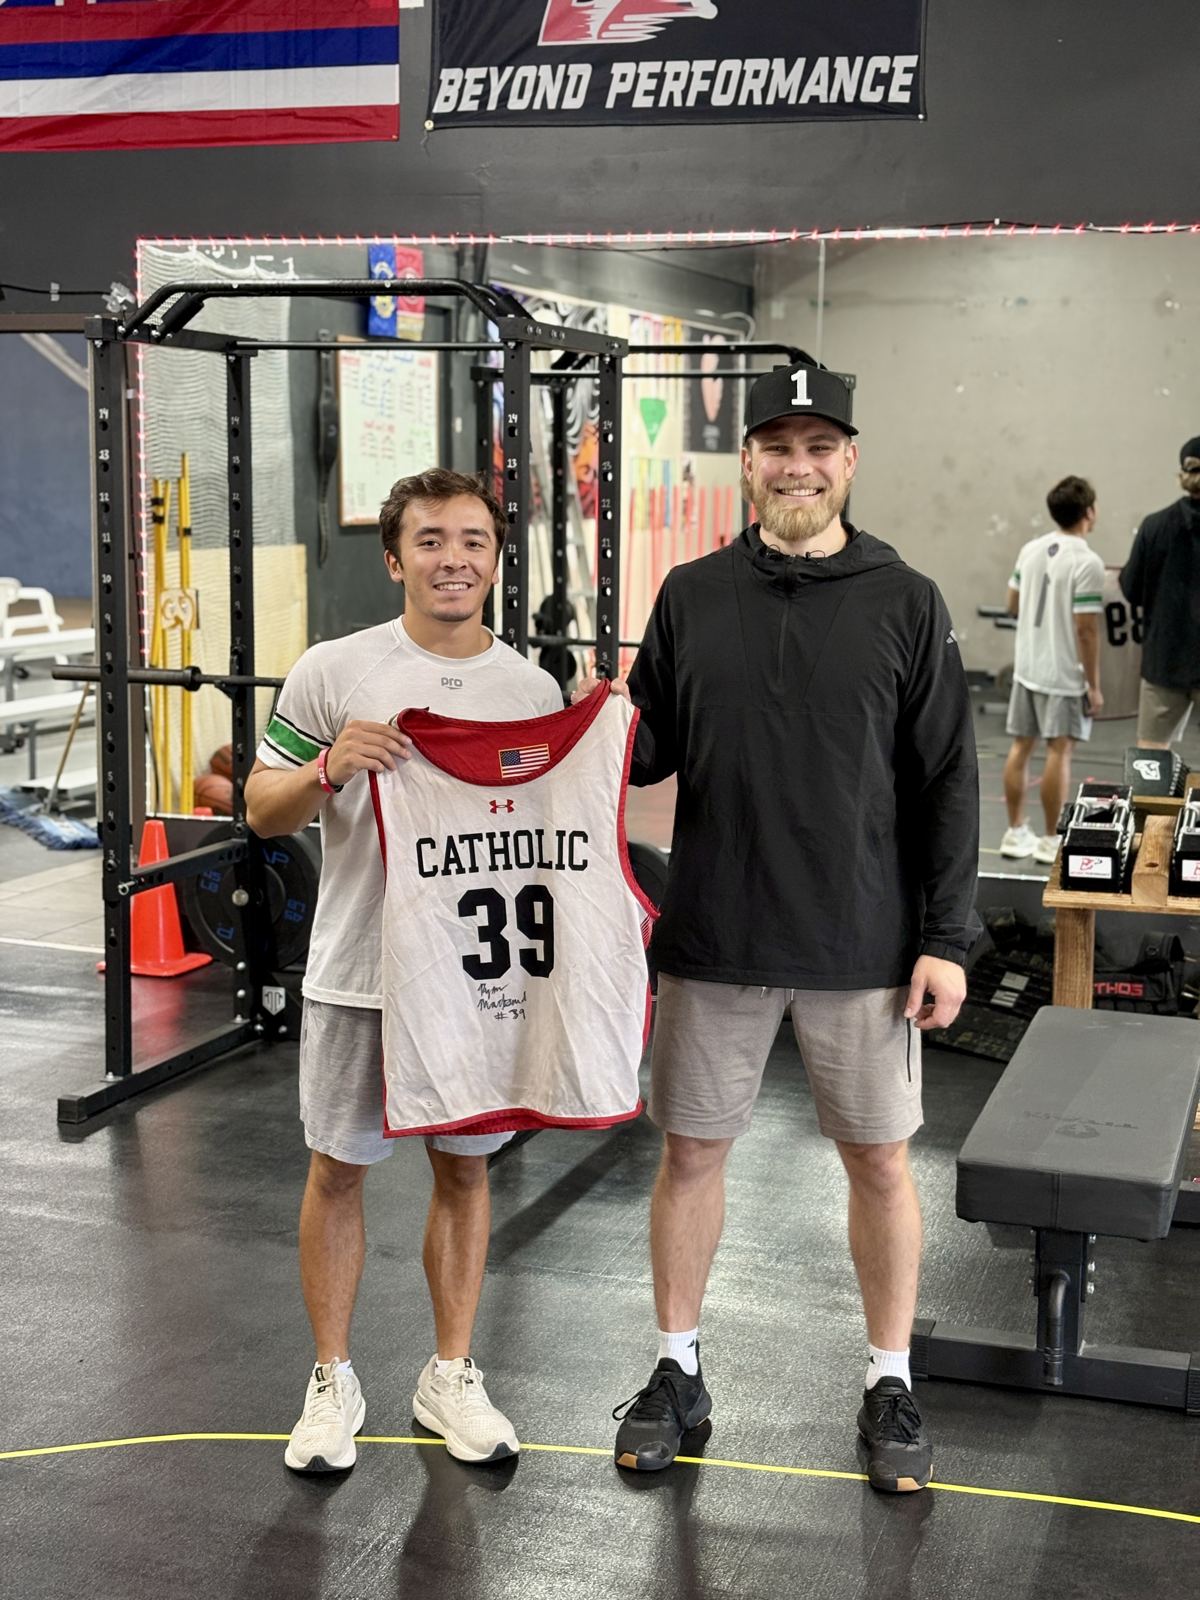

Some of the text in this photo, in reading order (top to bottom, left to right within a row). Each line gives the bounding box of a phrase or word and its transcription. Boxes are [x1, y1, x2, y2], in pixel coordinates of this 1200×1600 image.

[433, 54, 918, 114] BEYOND PERFORMANCE
[790, 369, 813, 406] 1
[98, 408, 109, 419] 14
[508, 413, 518, 423] 14
[603, 420, 613, 430] 14
[98, 449, 110, 460] 13
[507, 458, 517, 469] 13
[99, 492, 110, 502] 12
[508, 502, 518, 512] 12
[601, 499, 611, 508] 12
[102, 532, 111, 543] 11
[508, 544, 517, 553] 11
[101, 573, 112, 583] 10
[601, 576, 611, 585] 10
[507, 585, 518, 594] 10
[104, 613, 111, 623] 9
[508, 628, 515, 638] 9
[441, 677, 463, 689] pro
[107, 771, 113, 781] 5
[415, 829, 588, 878] CATHOLIC
[457, 884, 555, 980] 39
